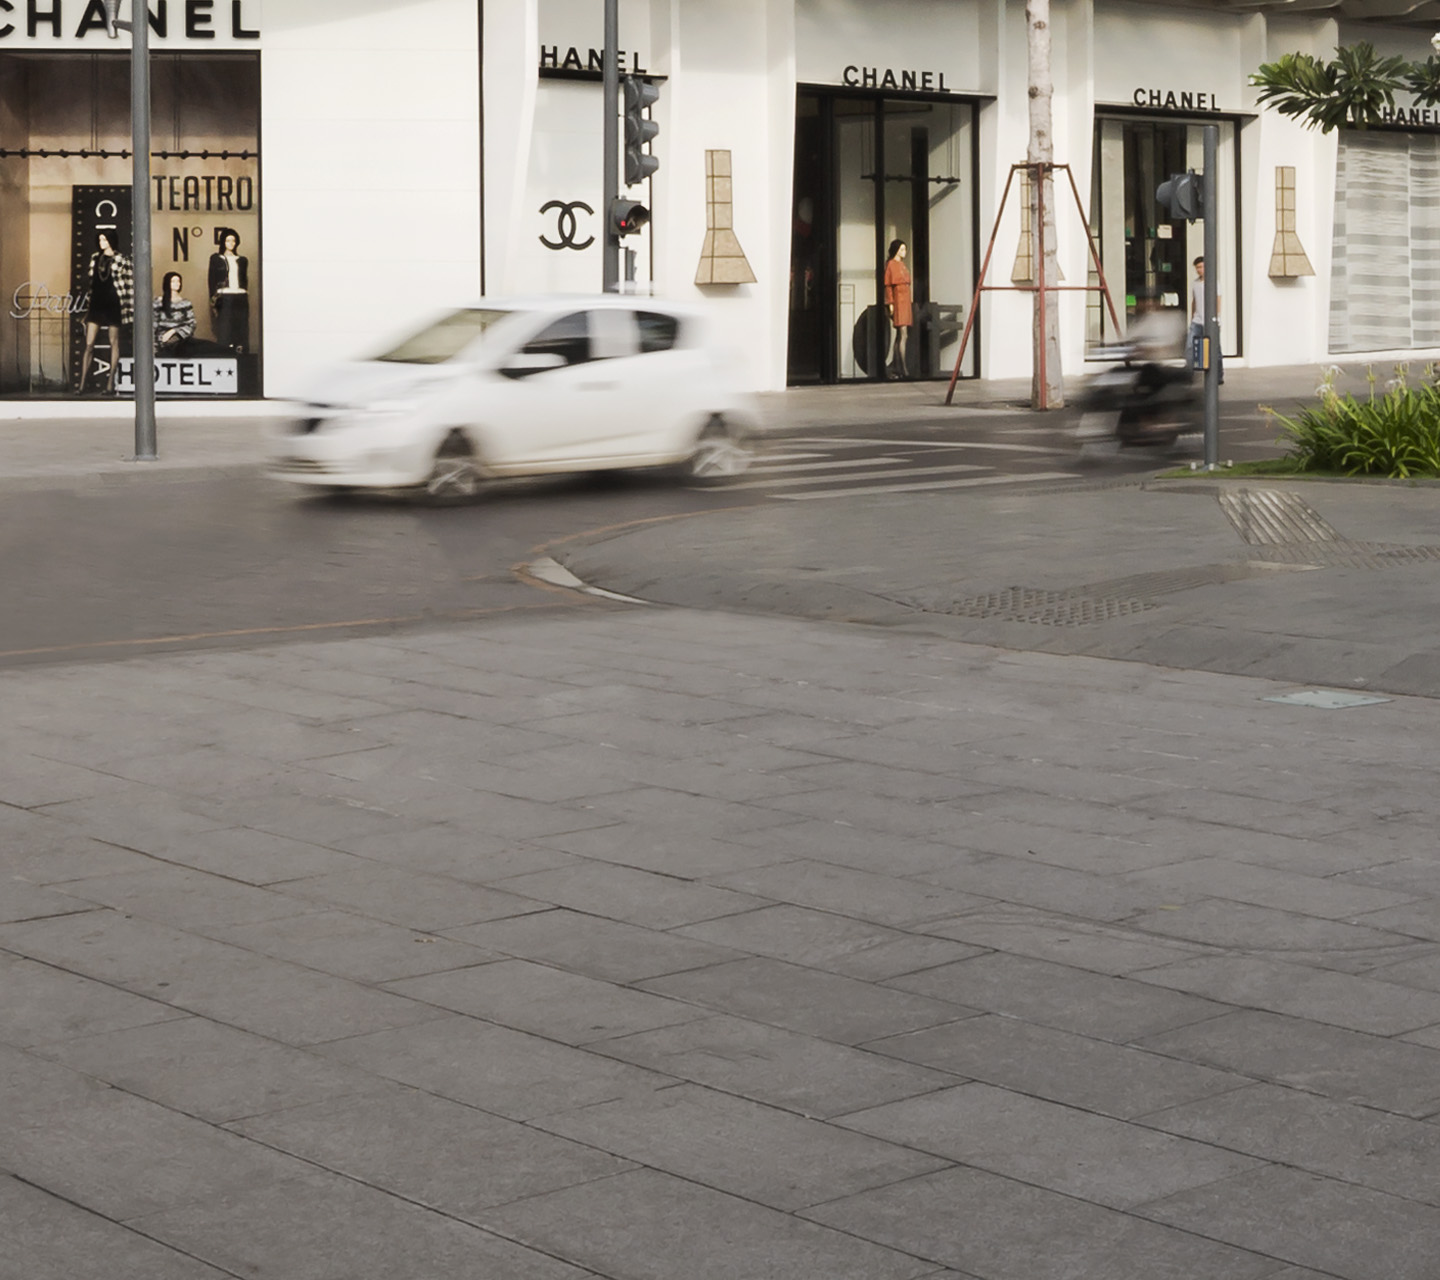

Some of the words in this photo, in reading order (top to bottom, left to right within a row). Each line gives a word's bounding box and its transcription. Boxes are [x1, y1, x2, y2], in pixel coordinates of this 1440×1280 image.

[843, 65, 951, 93] CHANEL
[1133, 88, 1222, 112] CHANEL
[152, 175, 253, 211] TEATRO
